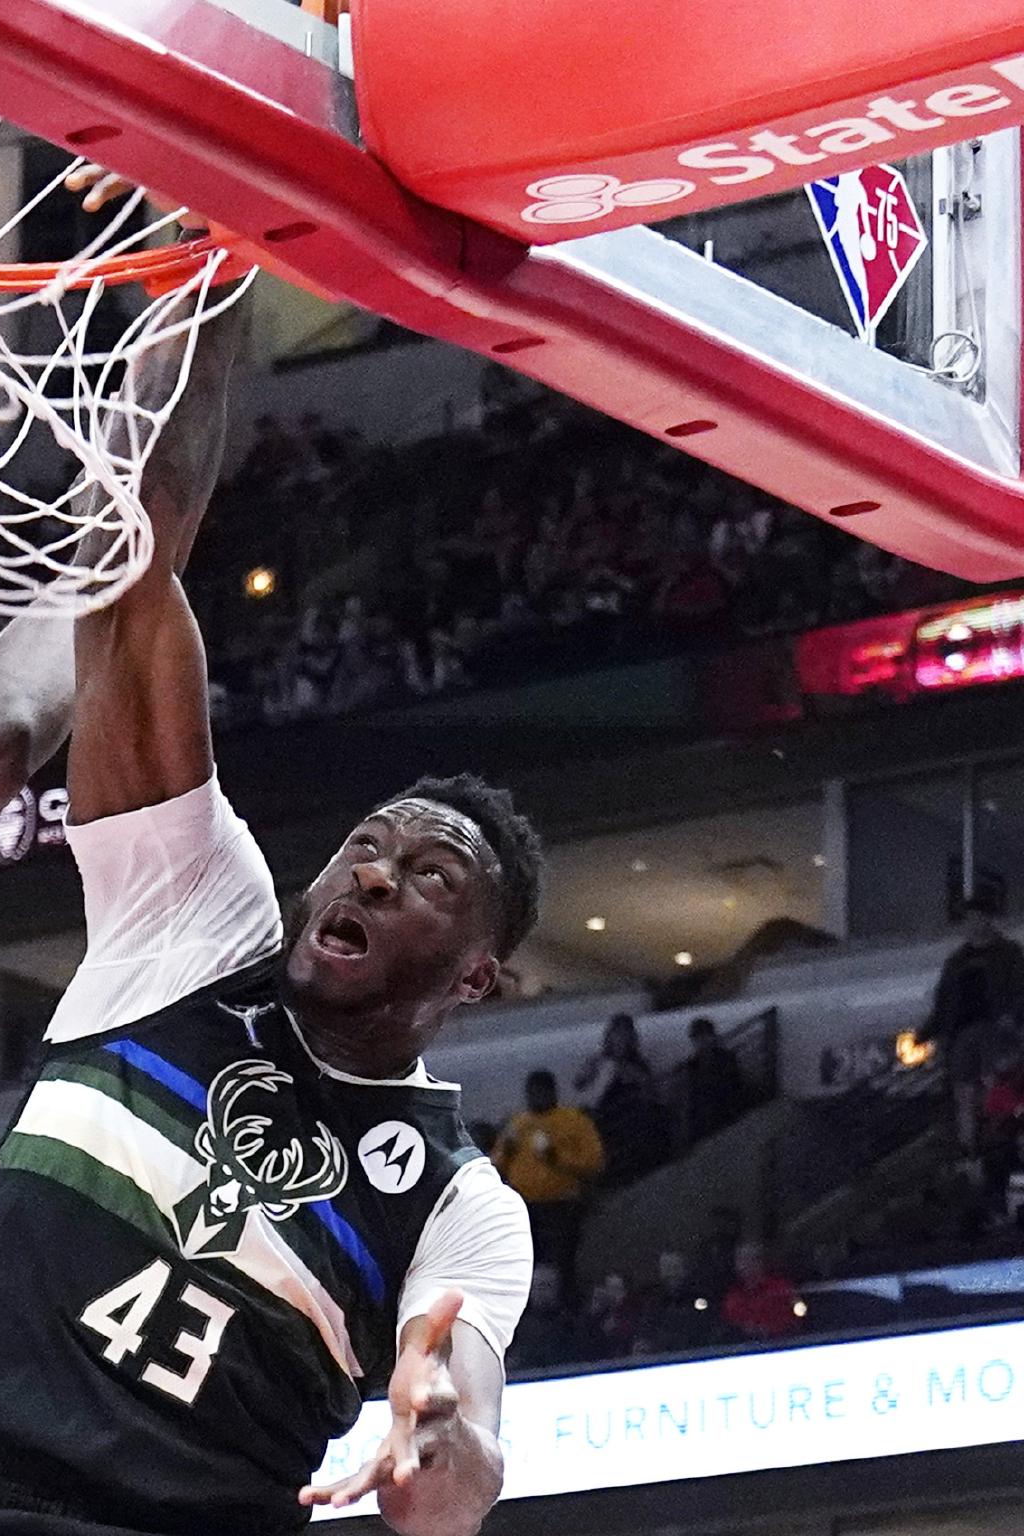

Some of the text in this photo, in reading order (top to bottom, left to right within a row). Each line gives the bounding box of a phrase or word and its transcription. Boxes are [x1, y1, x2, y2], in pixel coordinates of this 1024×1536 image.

[677, 83, 1012, 185] State
[875, 186, 898, 249] 75
[77, 1256, 238, 1407] 43
[554, 1378, 846, 1449] FURNITURE
[873, 1372, 900, 1415] &
